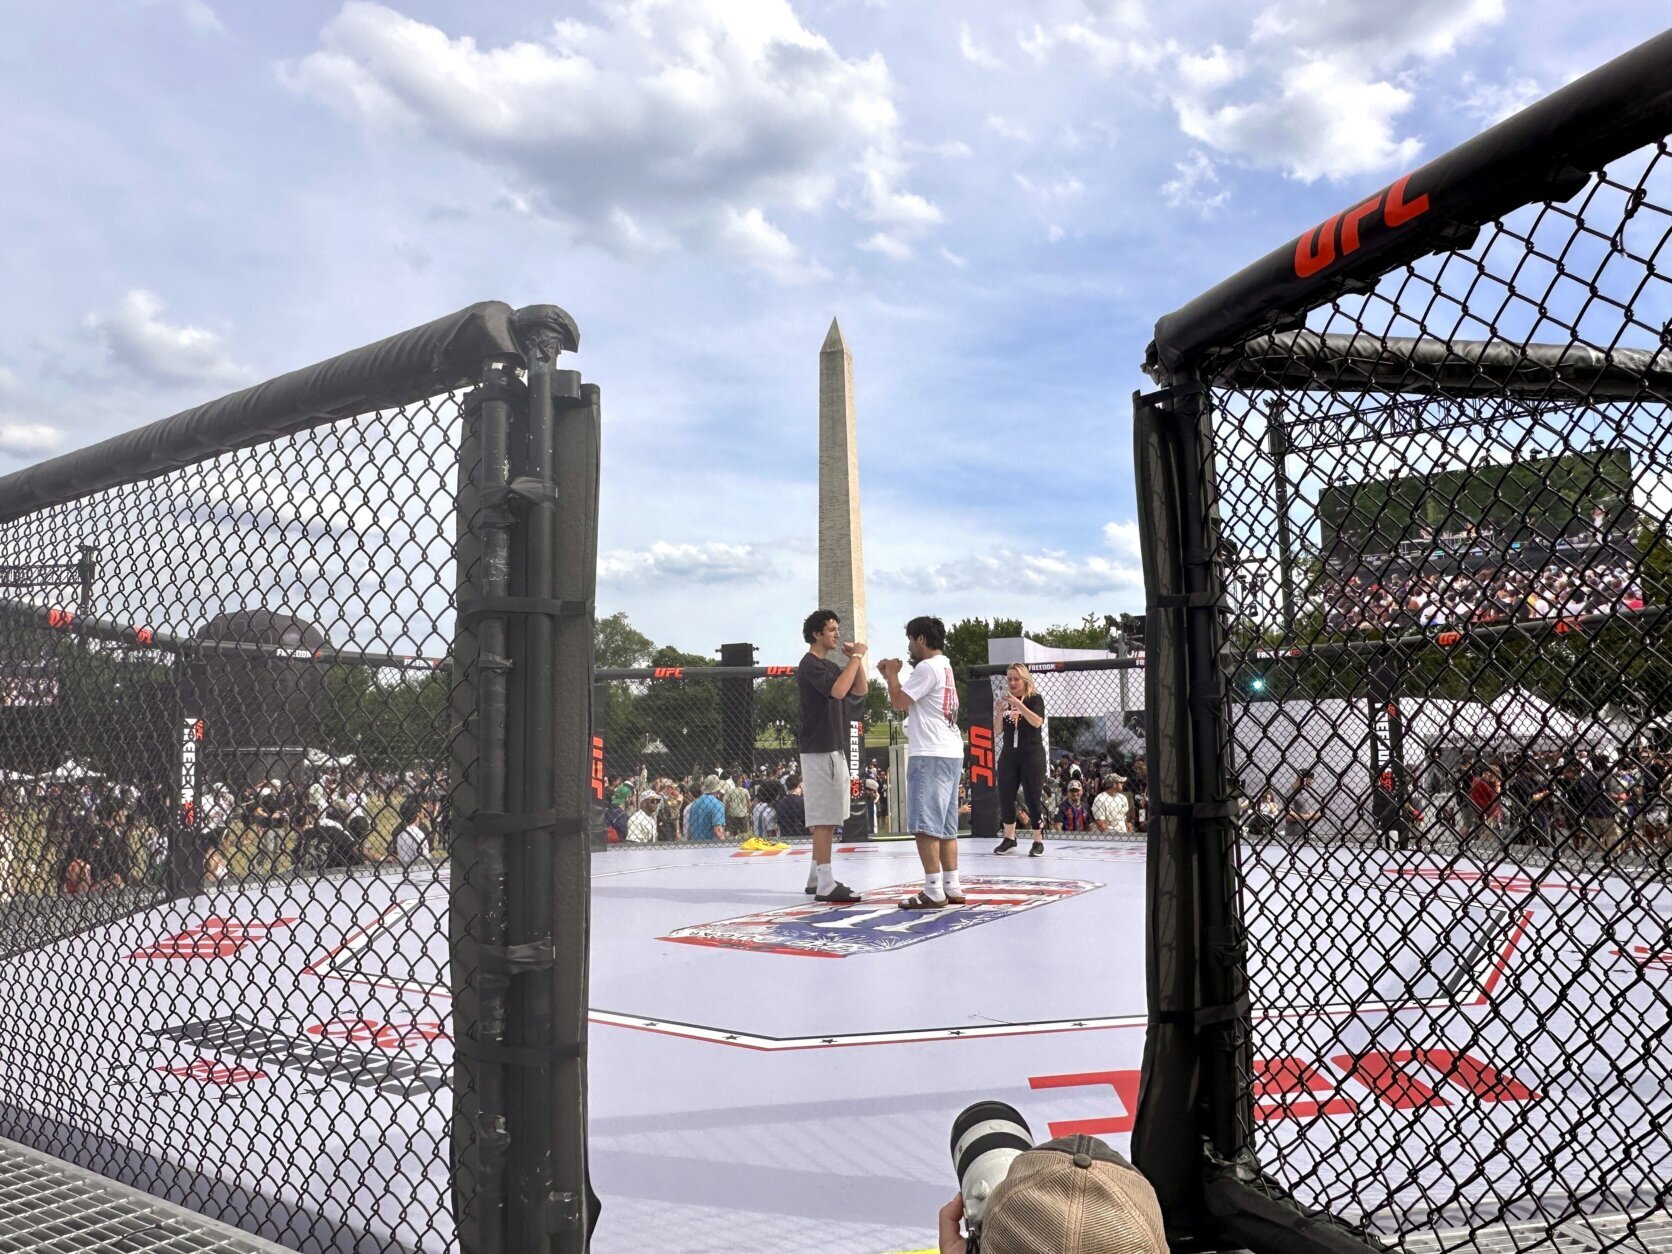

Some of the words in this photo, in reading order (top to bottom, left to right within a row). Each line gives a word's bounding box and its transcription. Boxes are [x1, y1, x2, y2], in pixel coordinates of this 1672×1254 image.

[1294, 173, 1430, 278] UFC
[655, 667, 684, 678] UFC
[767, 666, 794, 676] UFC
[970, 726, 994, 788] UFC
